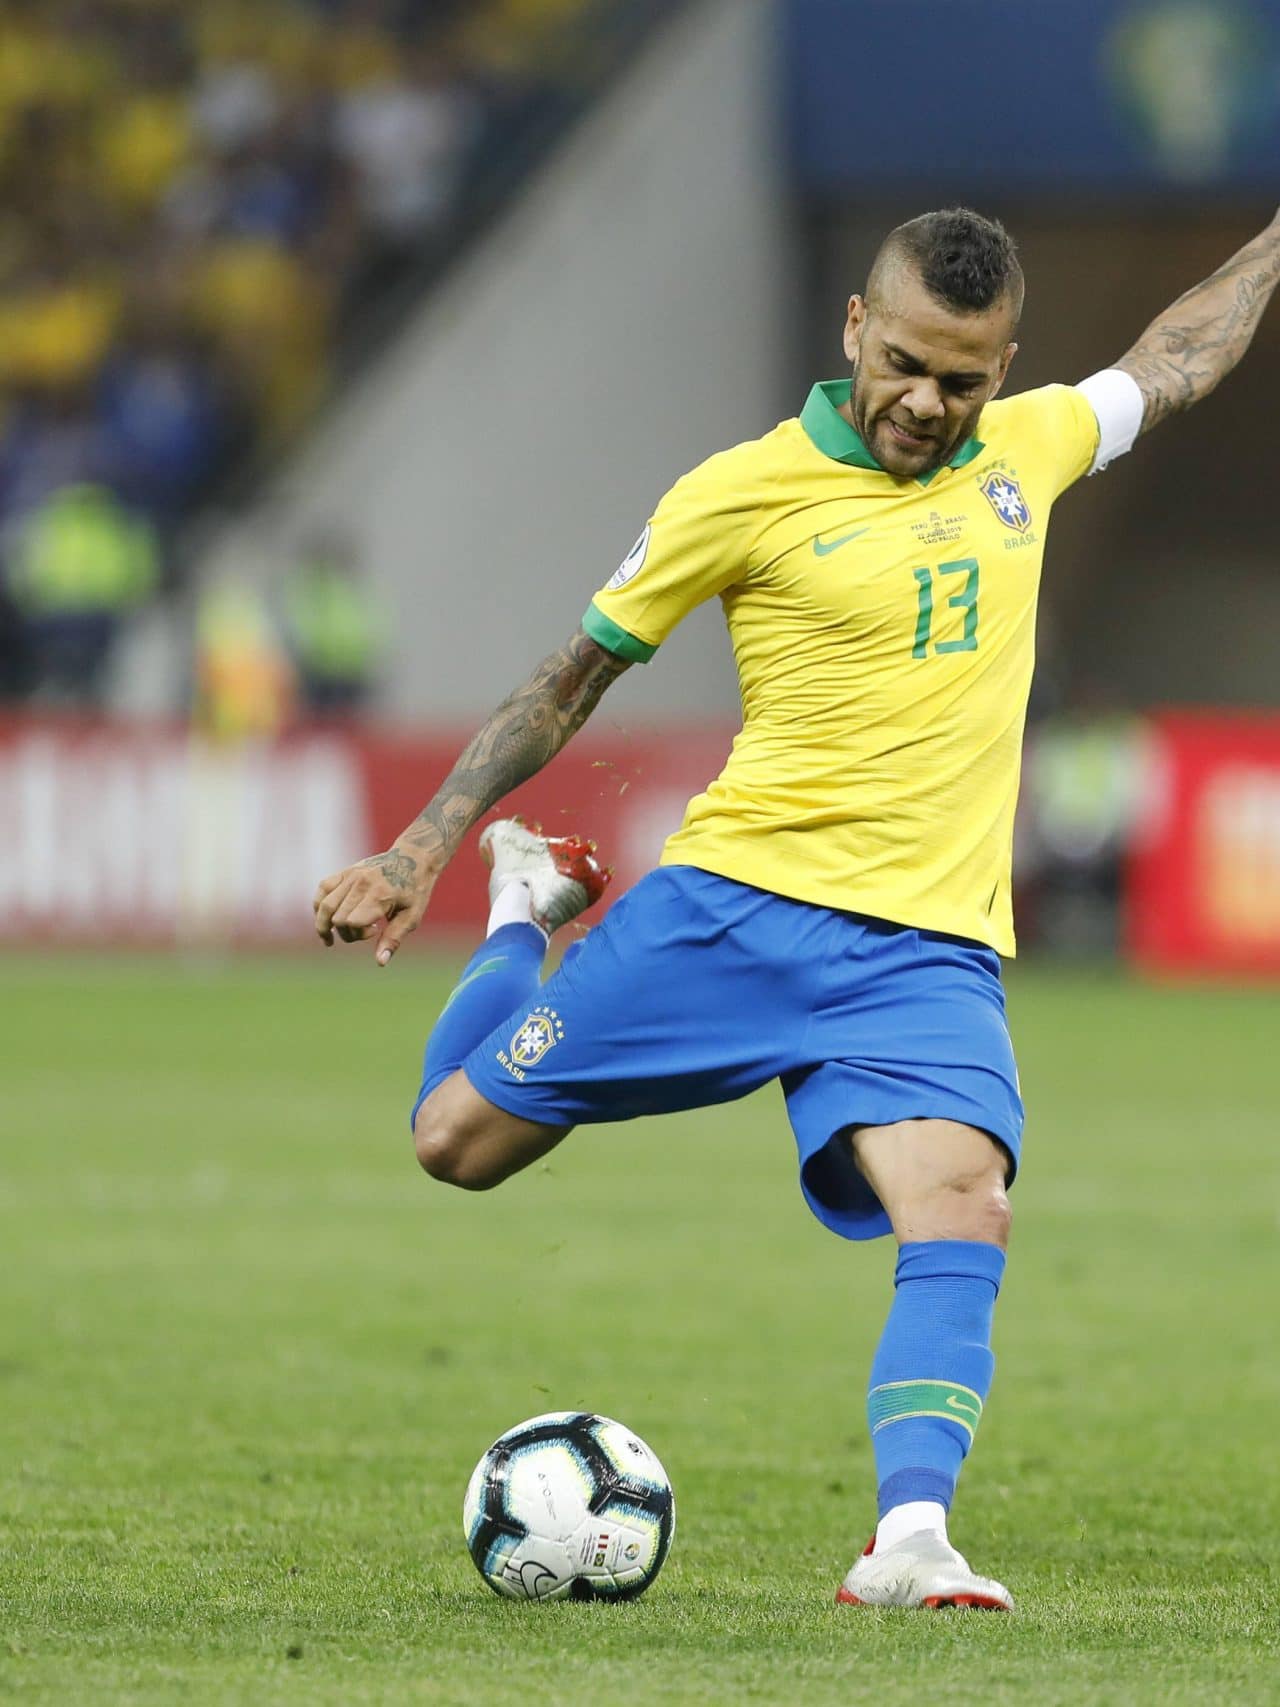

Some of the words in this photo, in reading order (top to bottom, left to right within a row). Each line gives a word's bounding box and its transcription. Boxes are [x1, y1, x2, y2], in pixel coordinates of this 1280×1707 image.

[1003, 532, 1038, 550] BRASIL
[912, 558, 979, 659] 13
[495, 1050, 526, 1082] BRASIL
